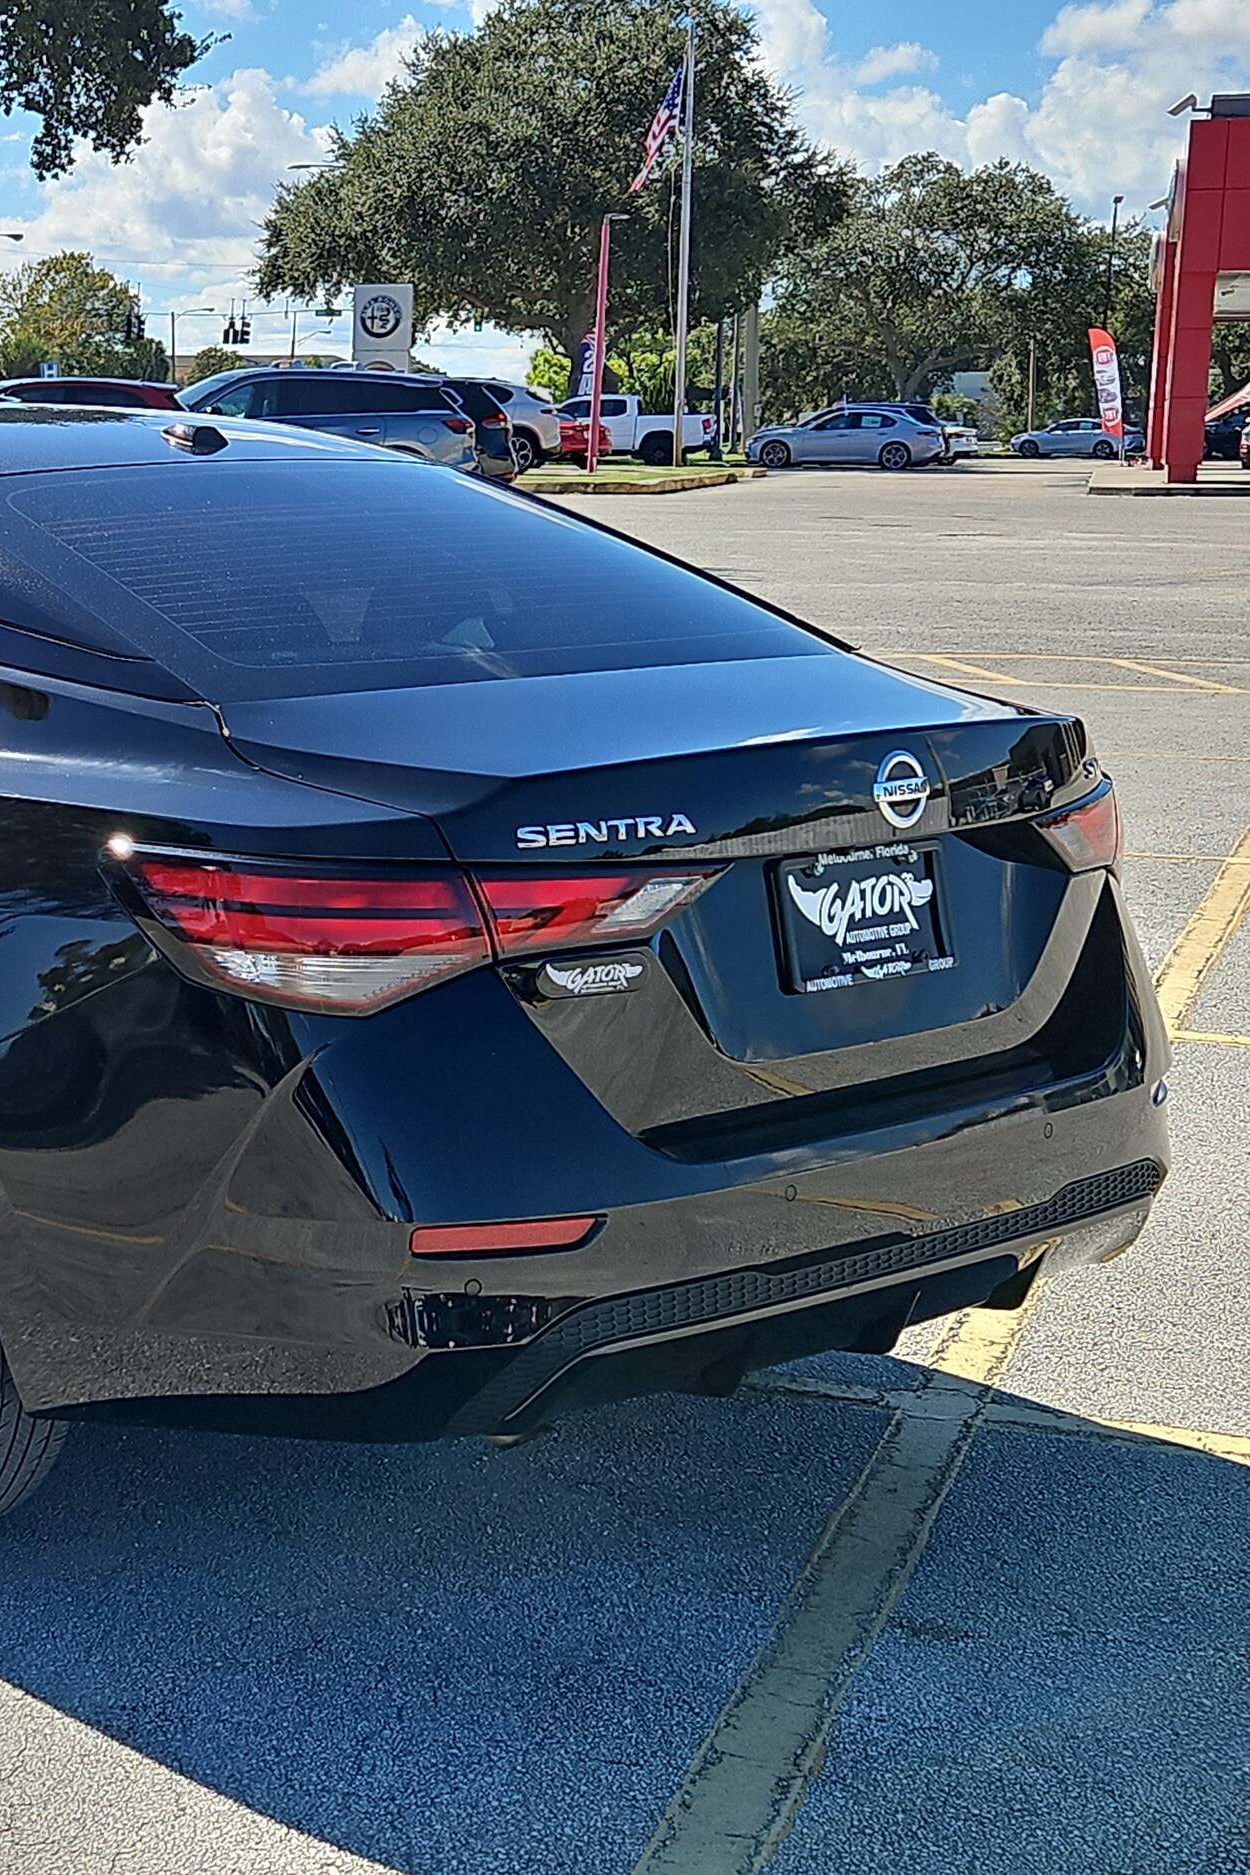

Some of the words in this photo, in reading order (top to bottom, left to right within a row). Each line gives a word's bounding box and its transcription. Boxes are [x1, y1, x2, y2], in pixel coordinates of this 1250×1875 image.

[882, 781, 928, 797] NISSAN
[517, 814, 697, 849] SENTRA
[875, 843, 909, 858] Florida
[821, 874, 920, 947] GATOR
[846, 926, 889, 944] AUTOMOTIVE
[889, 922, 911, 937] GROUP
[566, 963, 628, 994] GATOR
[806, 974, 854, 993] AUTOMOTIVE
[876, 961, 907, 979] GATOR
[928, 957, 954, 972] GROUP
